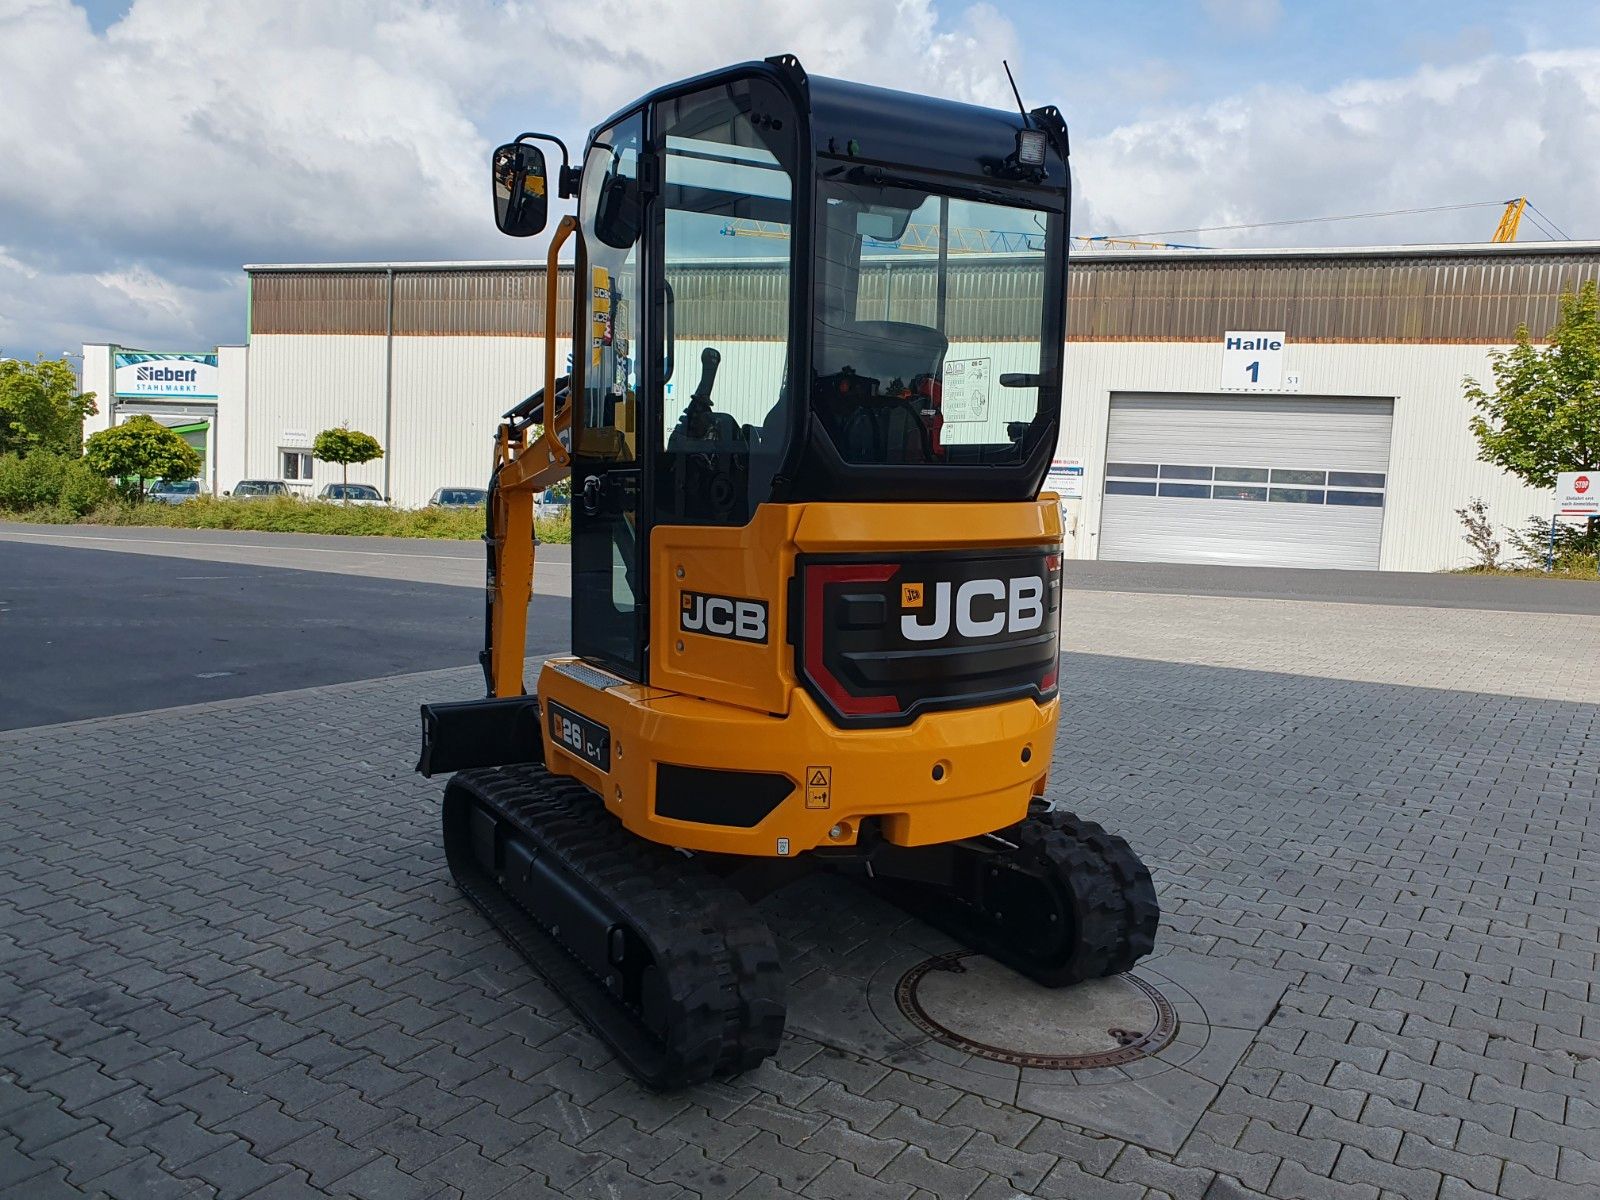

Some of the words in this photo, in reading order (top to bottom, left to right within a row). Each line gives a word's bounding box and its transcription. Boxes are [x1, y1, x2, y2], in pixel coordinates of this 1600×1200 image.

[1227, 338, 1281, 351] Halle
[136, 366, 197, 382] Siebert
[1245, 361, 1260, 383] 1
[1575, 480, 1589, 488] STOP
[682, 596, 766, 640] JCB
[901, 575, 1044, 641] JCB
[563, 718, 582, 750] 26
